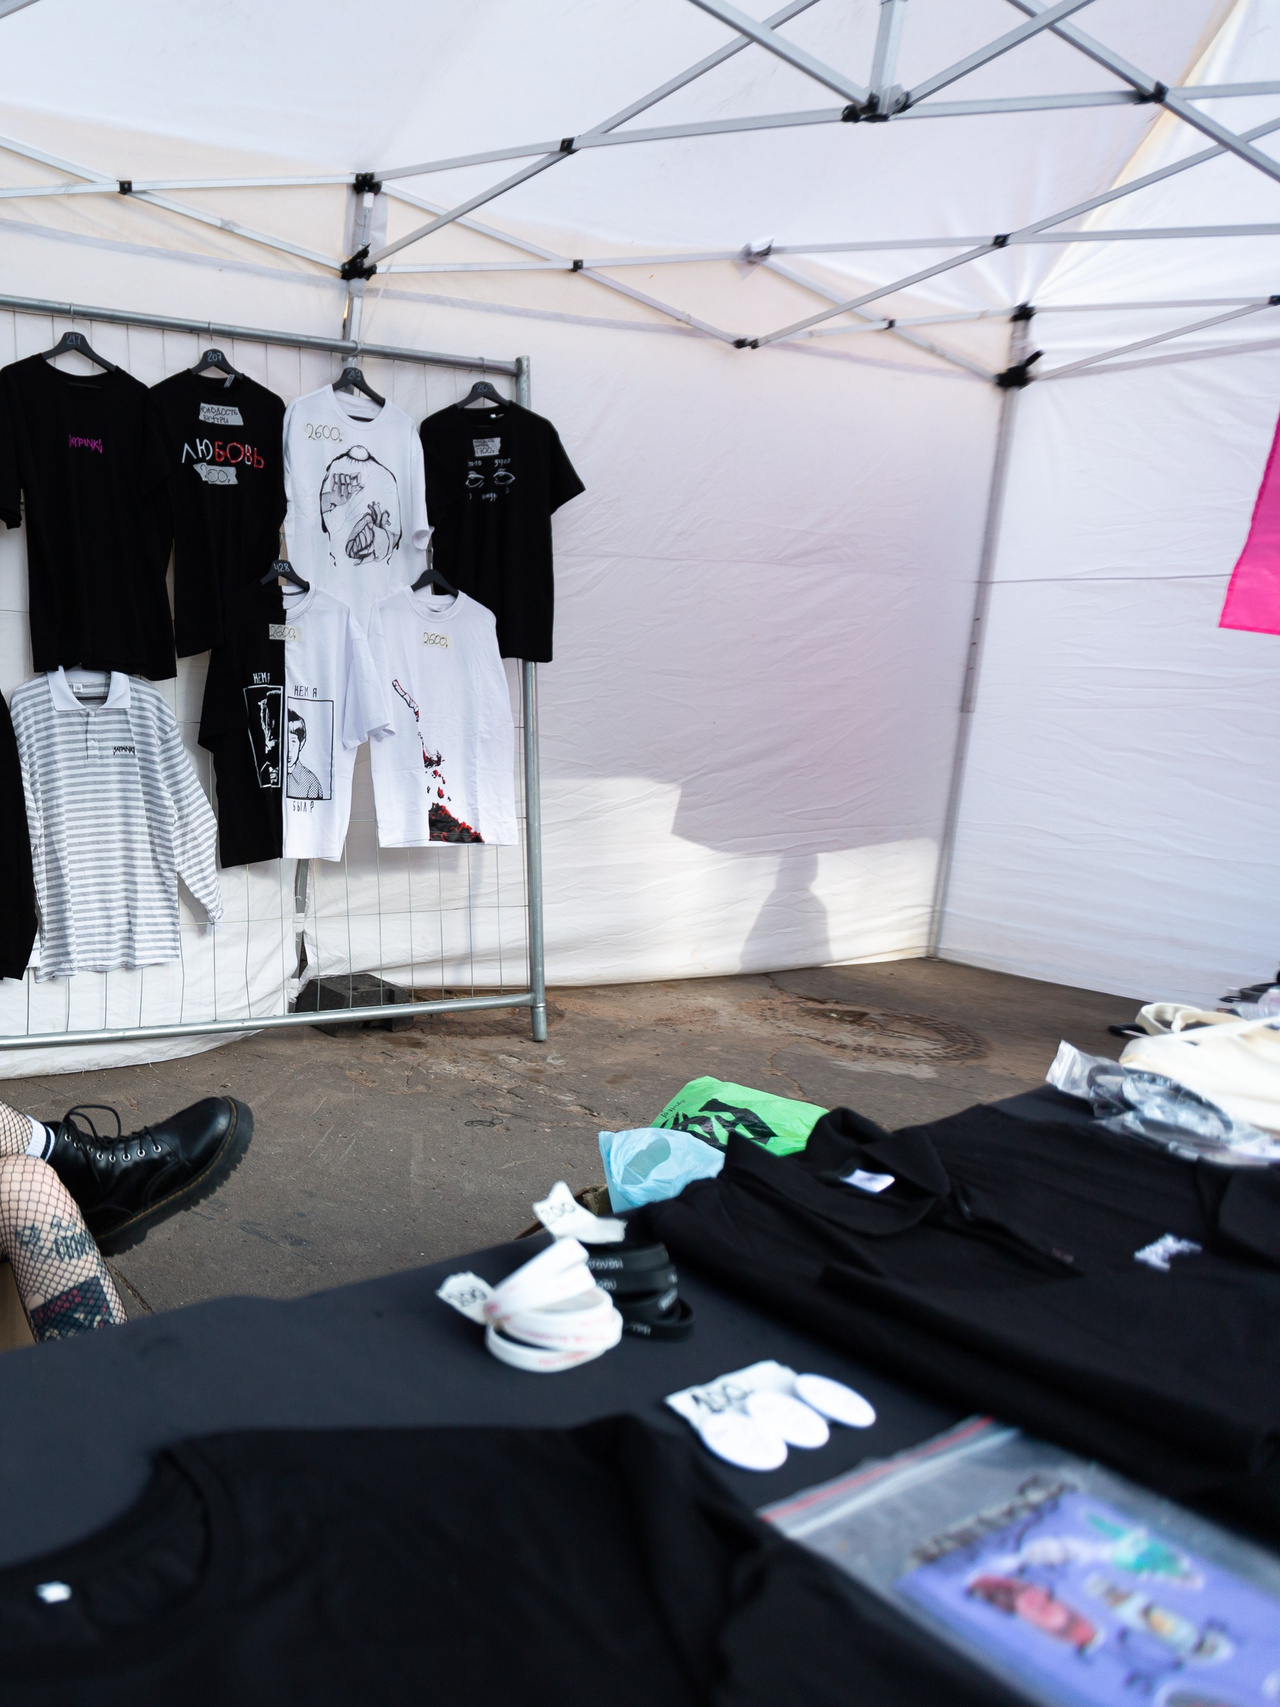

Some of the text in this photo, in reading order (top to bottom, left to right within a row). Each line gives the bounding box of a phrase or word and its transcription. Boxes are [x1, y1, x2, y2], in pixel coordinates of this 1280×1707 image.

[65, 333, 81, 345] 217
[207, 350, 222, 362] 207
[181, 438, 265, 469] ЛЮБОВЬ
[273, 562, 291, 573] 428
